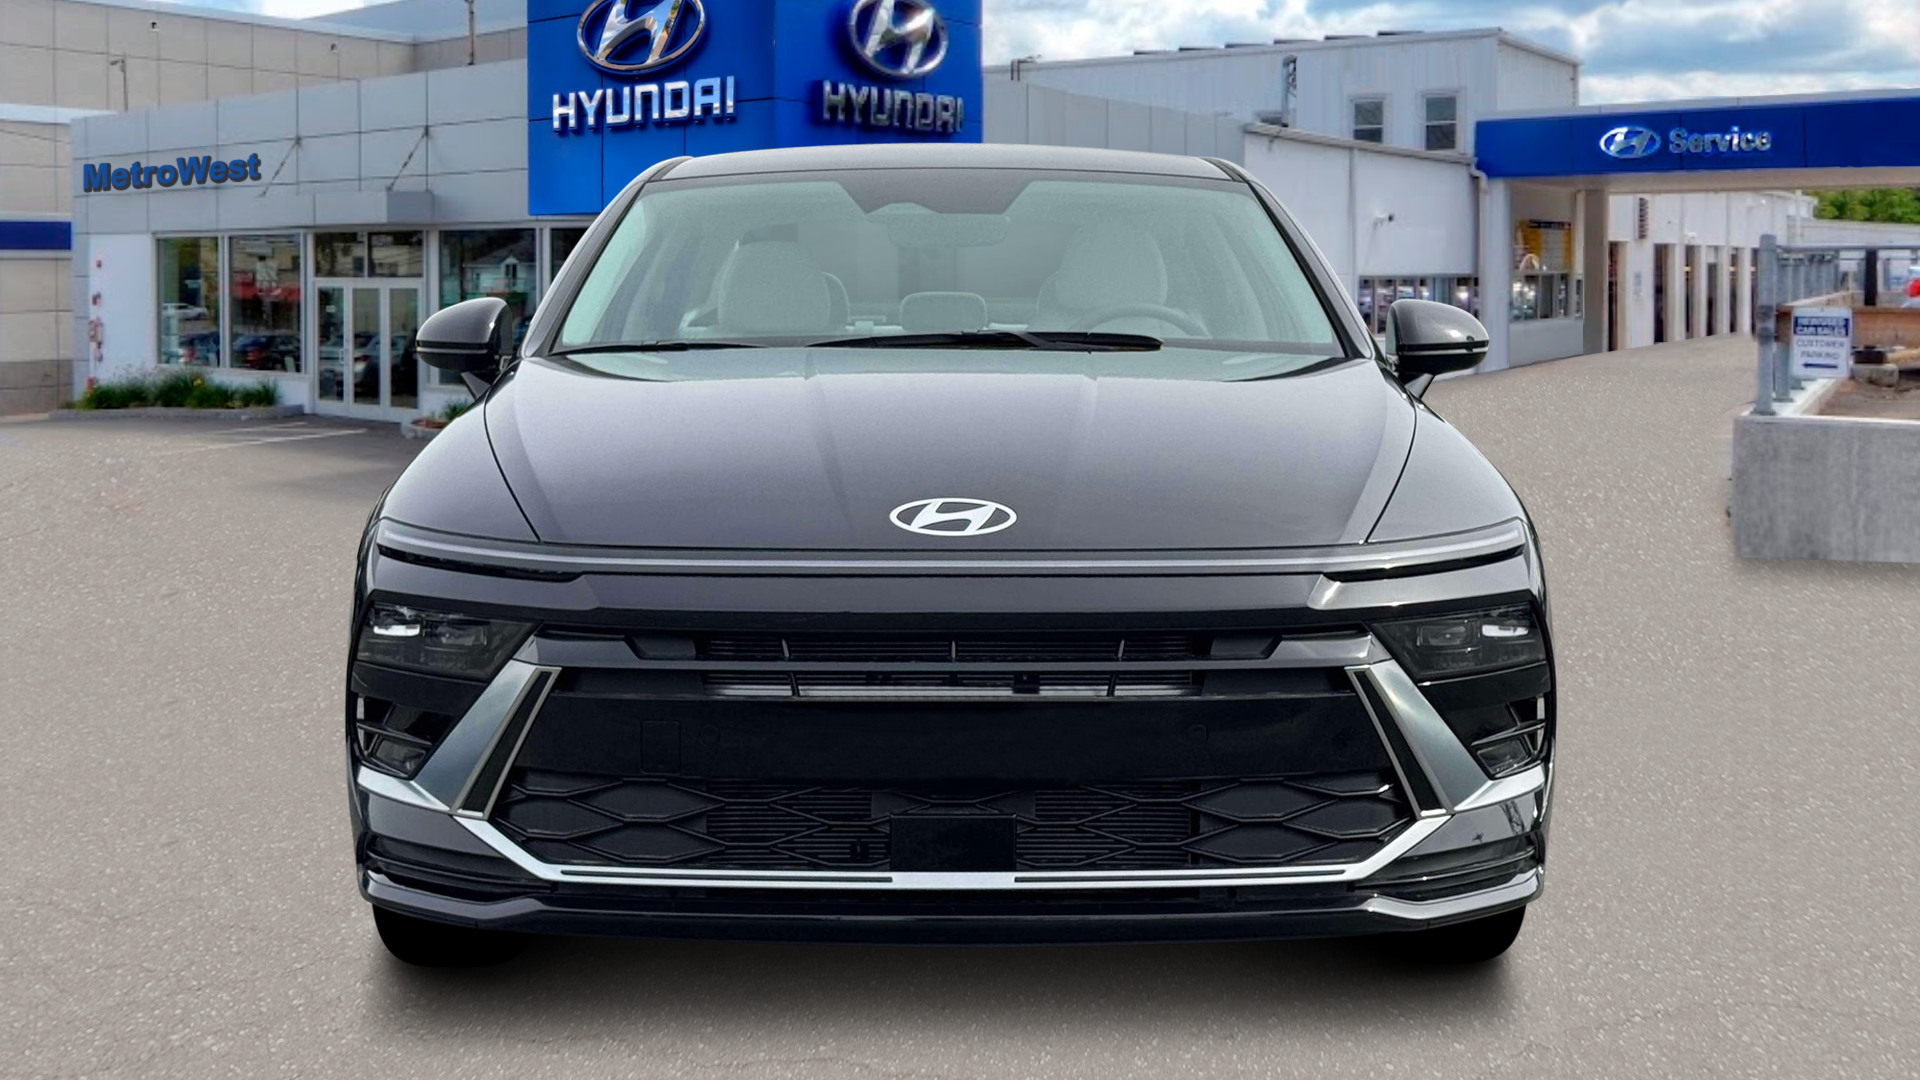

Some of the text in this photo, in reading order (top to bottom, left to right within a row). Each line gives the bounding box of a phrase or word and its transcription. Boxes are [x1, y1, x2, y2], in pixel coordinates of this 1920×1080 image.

[552, 75, 735, 131] HYUNDAI
[822, 79, 965, 133] HYUNDAI
[1669, 125, 1772, 154] Service
[83, 153, 262, 193] MetroWest
[1796, 339, 1844, 349] CUSTOMER
[1801, 350, 1840, 360] PARKING
